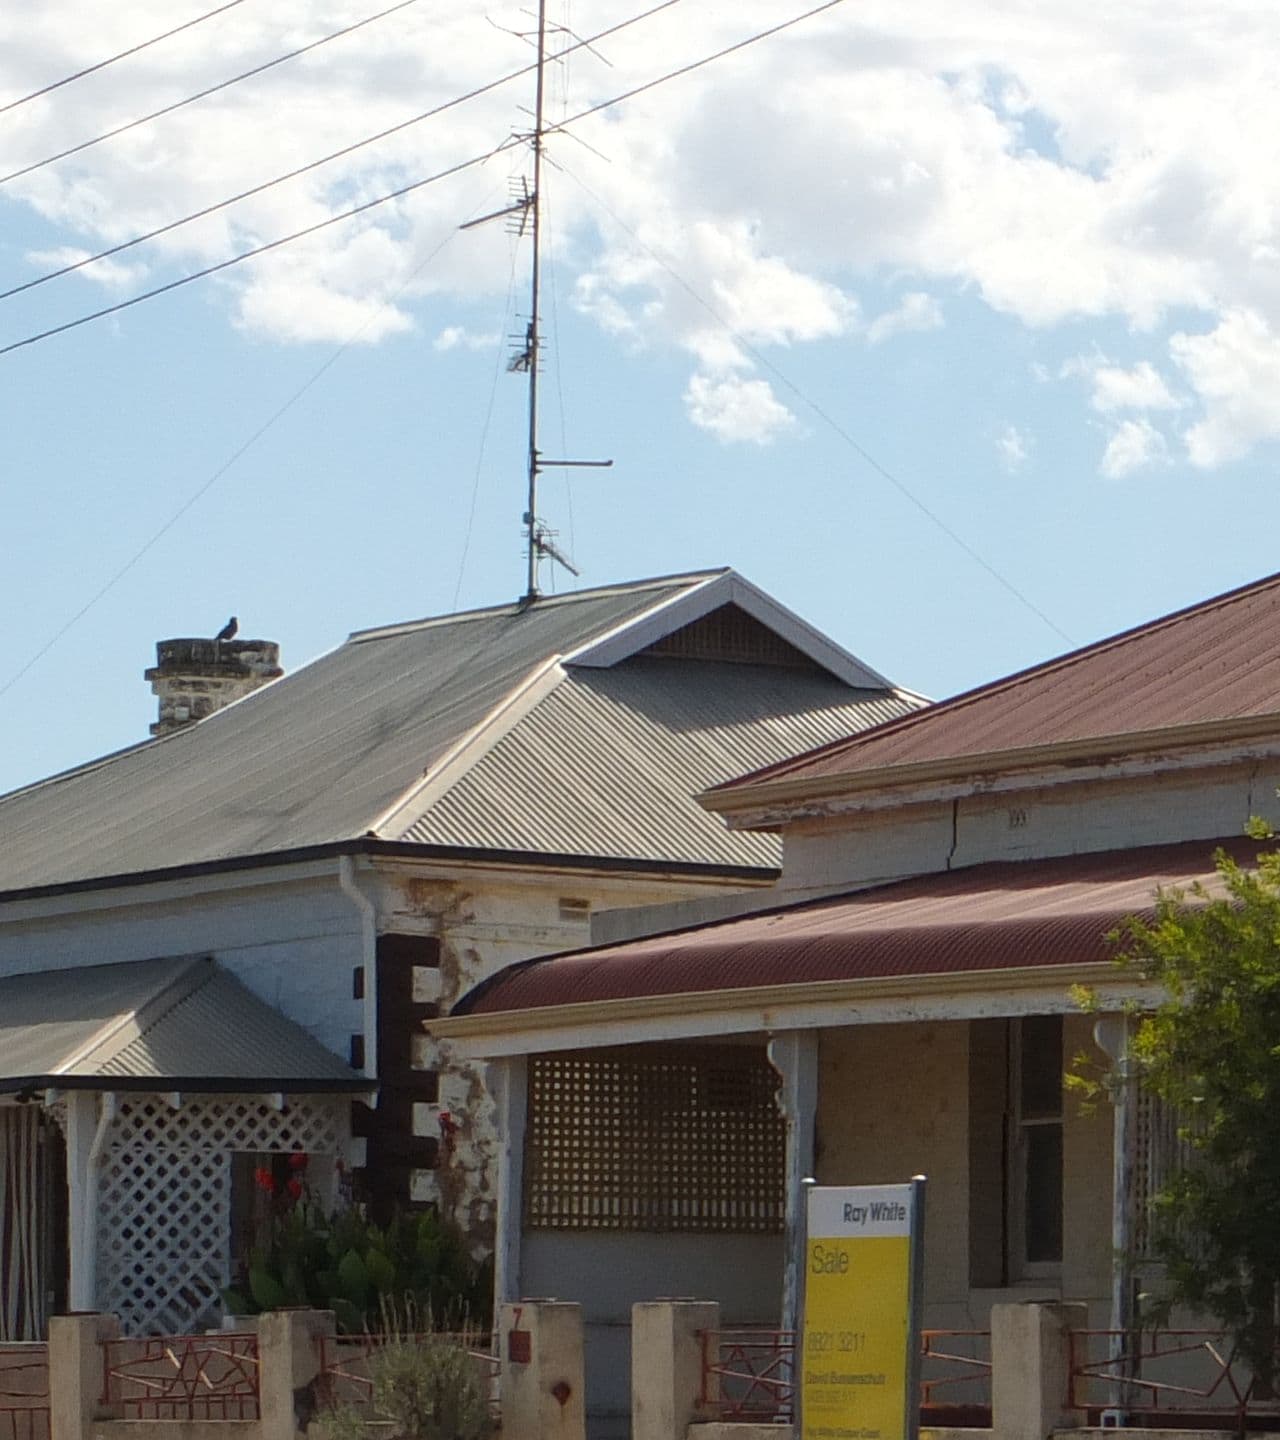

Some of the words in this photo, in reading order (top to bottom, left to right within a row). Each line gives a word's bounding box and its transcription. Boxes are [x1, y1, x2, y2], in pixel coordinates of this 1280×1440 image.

[844, 1202, 868, 1225] Ray
[869, 1201, 906, 1221] White
[812, 1245, 849, 1274] Sale
[513, 1307, 522, 1329] 7
